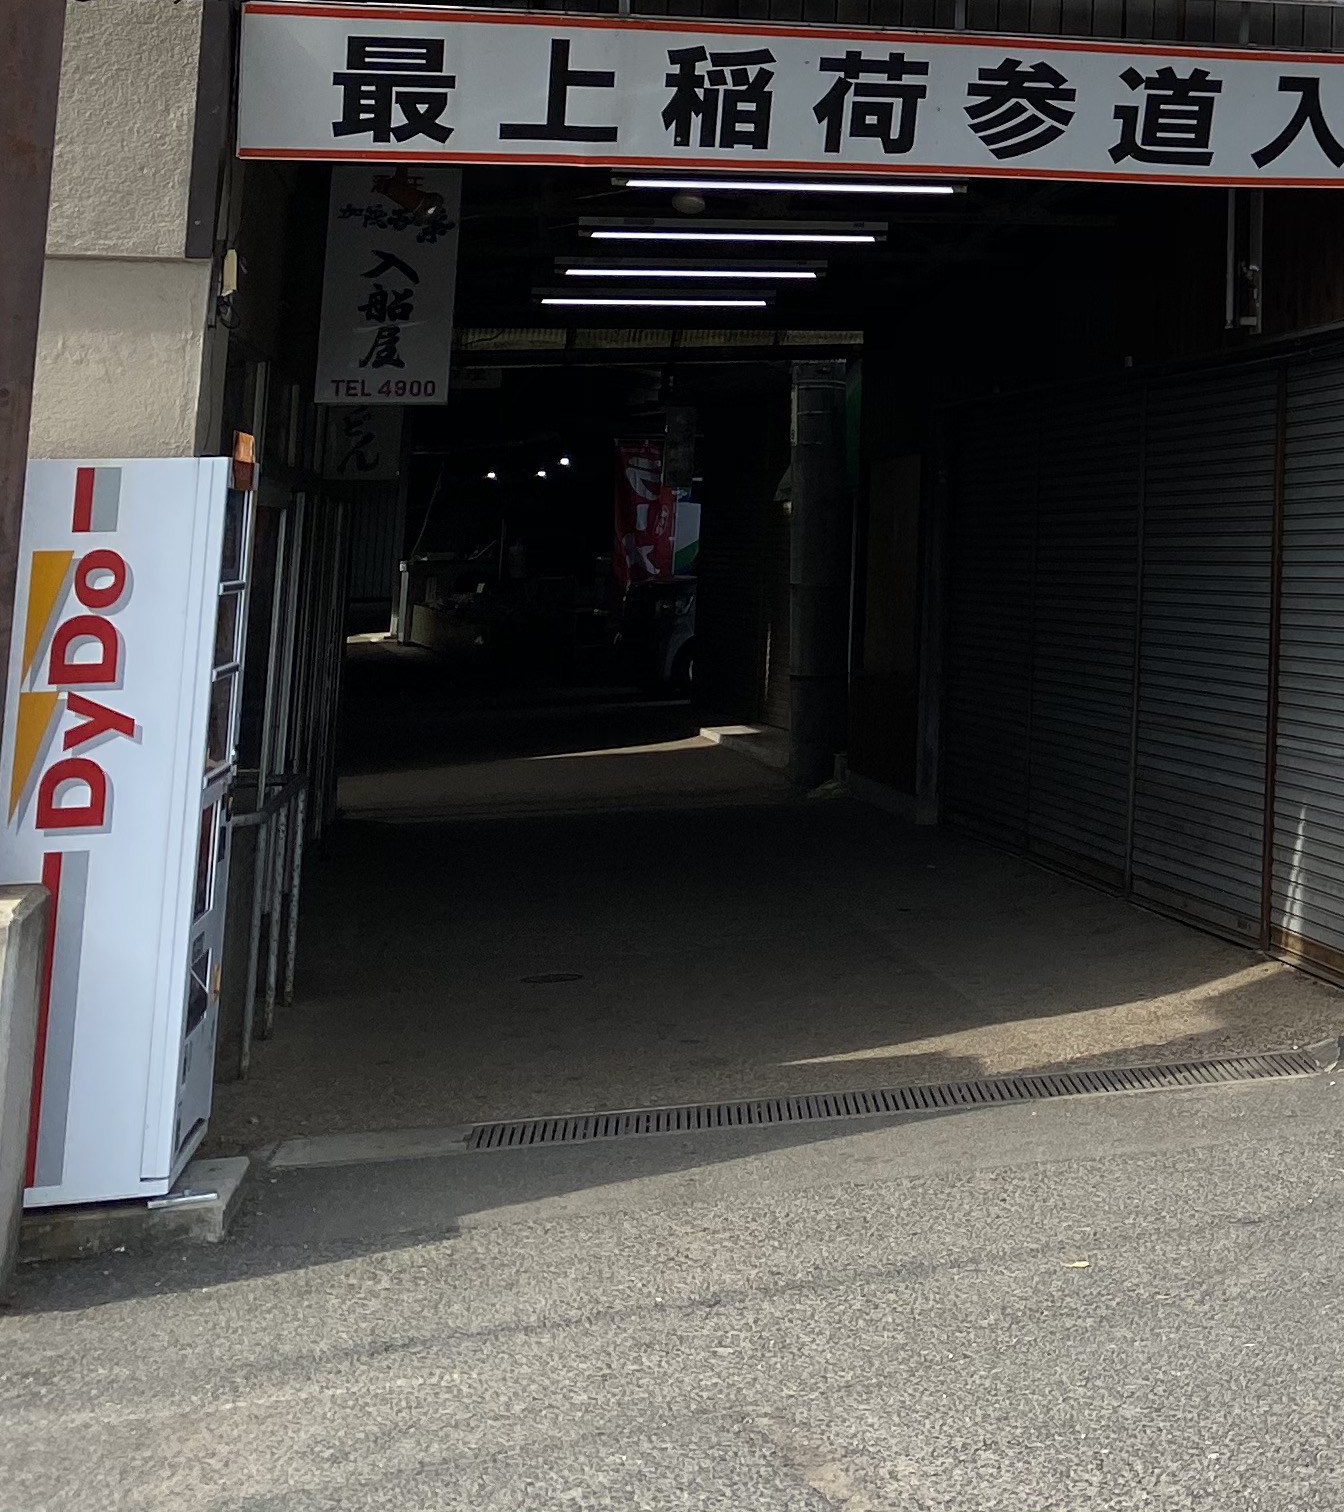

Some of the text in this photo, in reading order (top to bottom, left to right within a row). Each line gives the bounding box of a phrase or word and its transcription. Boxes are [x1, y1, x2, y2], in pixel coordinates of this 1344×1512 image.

[357, 249, 420, 369] 入船屋
[330, 379, 436, 397] TEL 4900
[35, 548, 136, 831] DyDo
